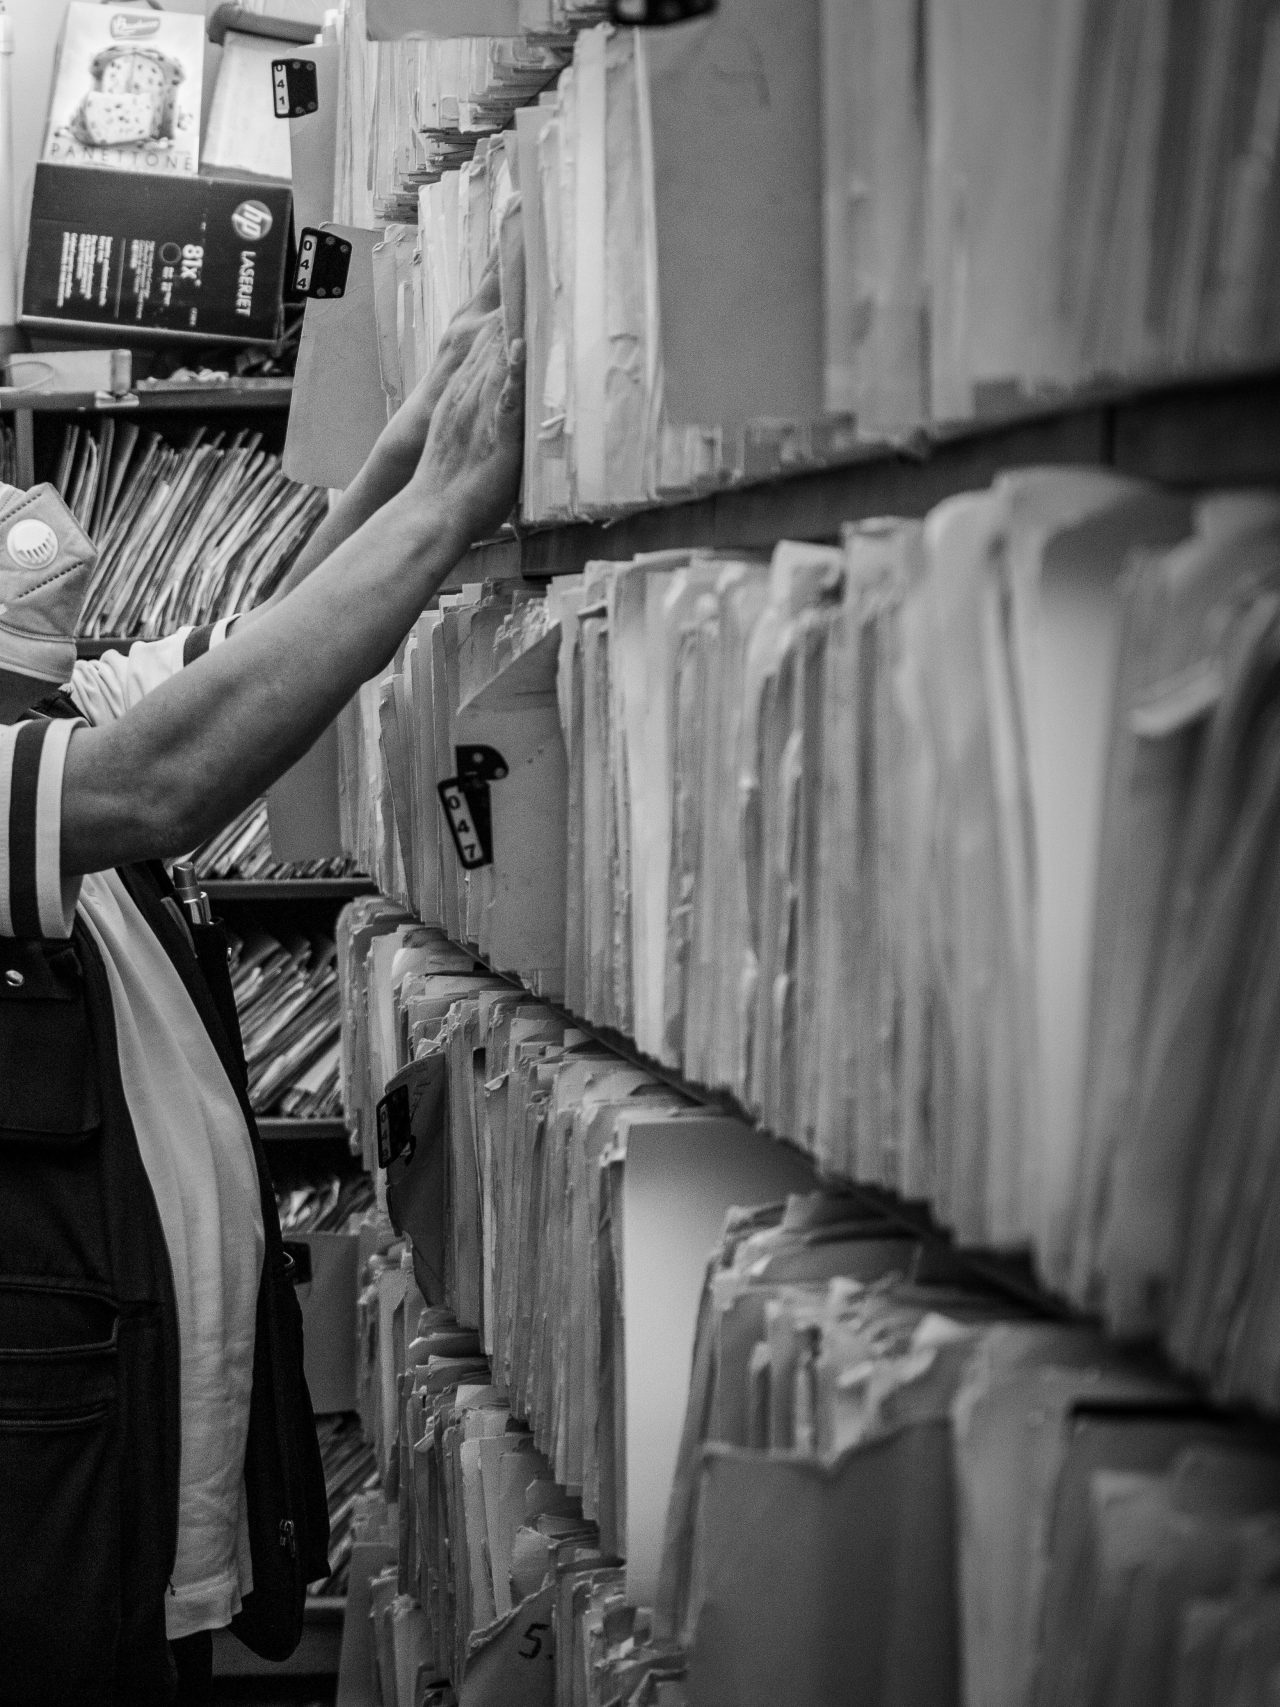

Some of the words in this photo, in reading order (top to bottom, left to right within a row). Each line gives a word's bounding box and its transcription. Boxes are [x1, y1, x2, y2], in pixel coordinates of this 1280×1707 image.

[50, 142, 193, 171] PANETTONE
[231, 200, 273, 241] hp
[235, 250, 257, 317] LASERJET
[297, 240, 313, 289] 044
[446, 795, 476, 859] 047
